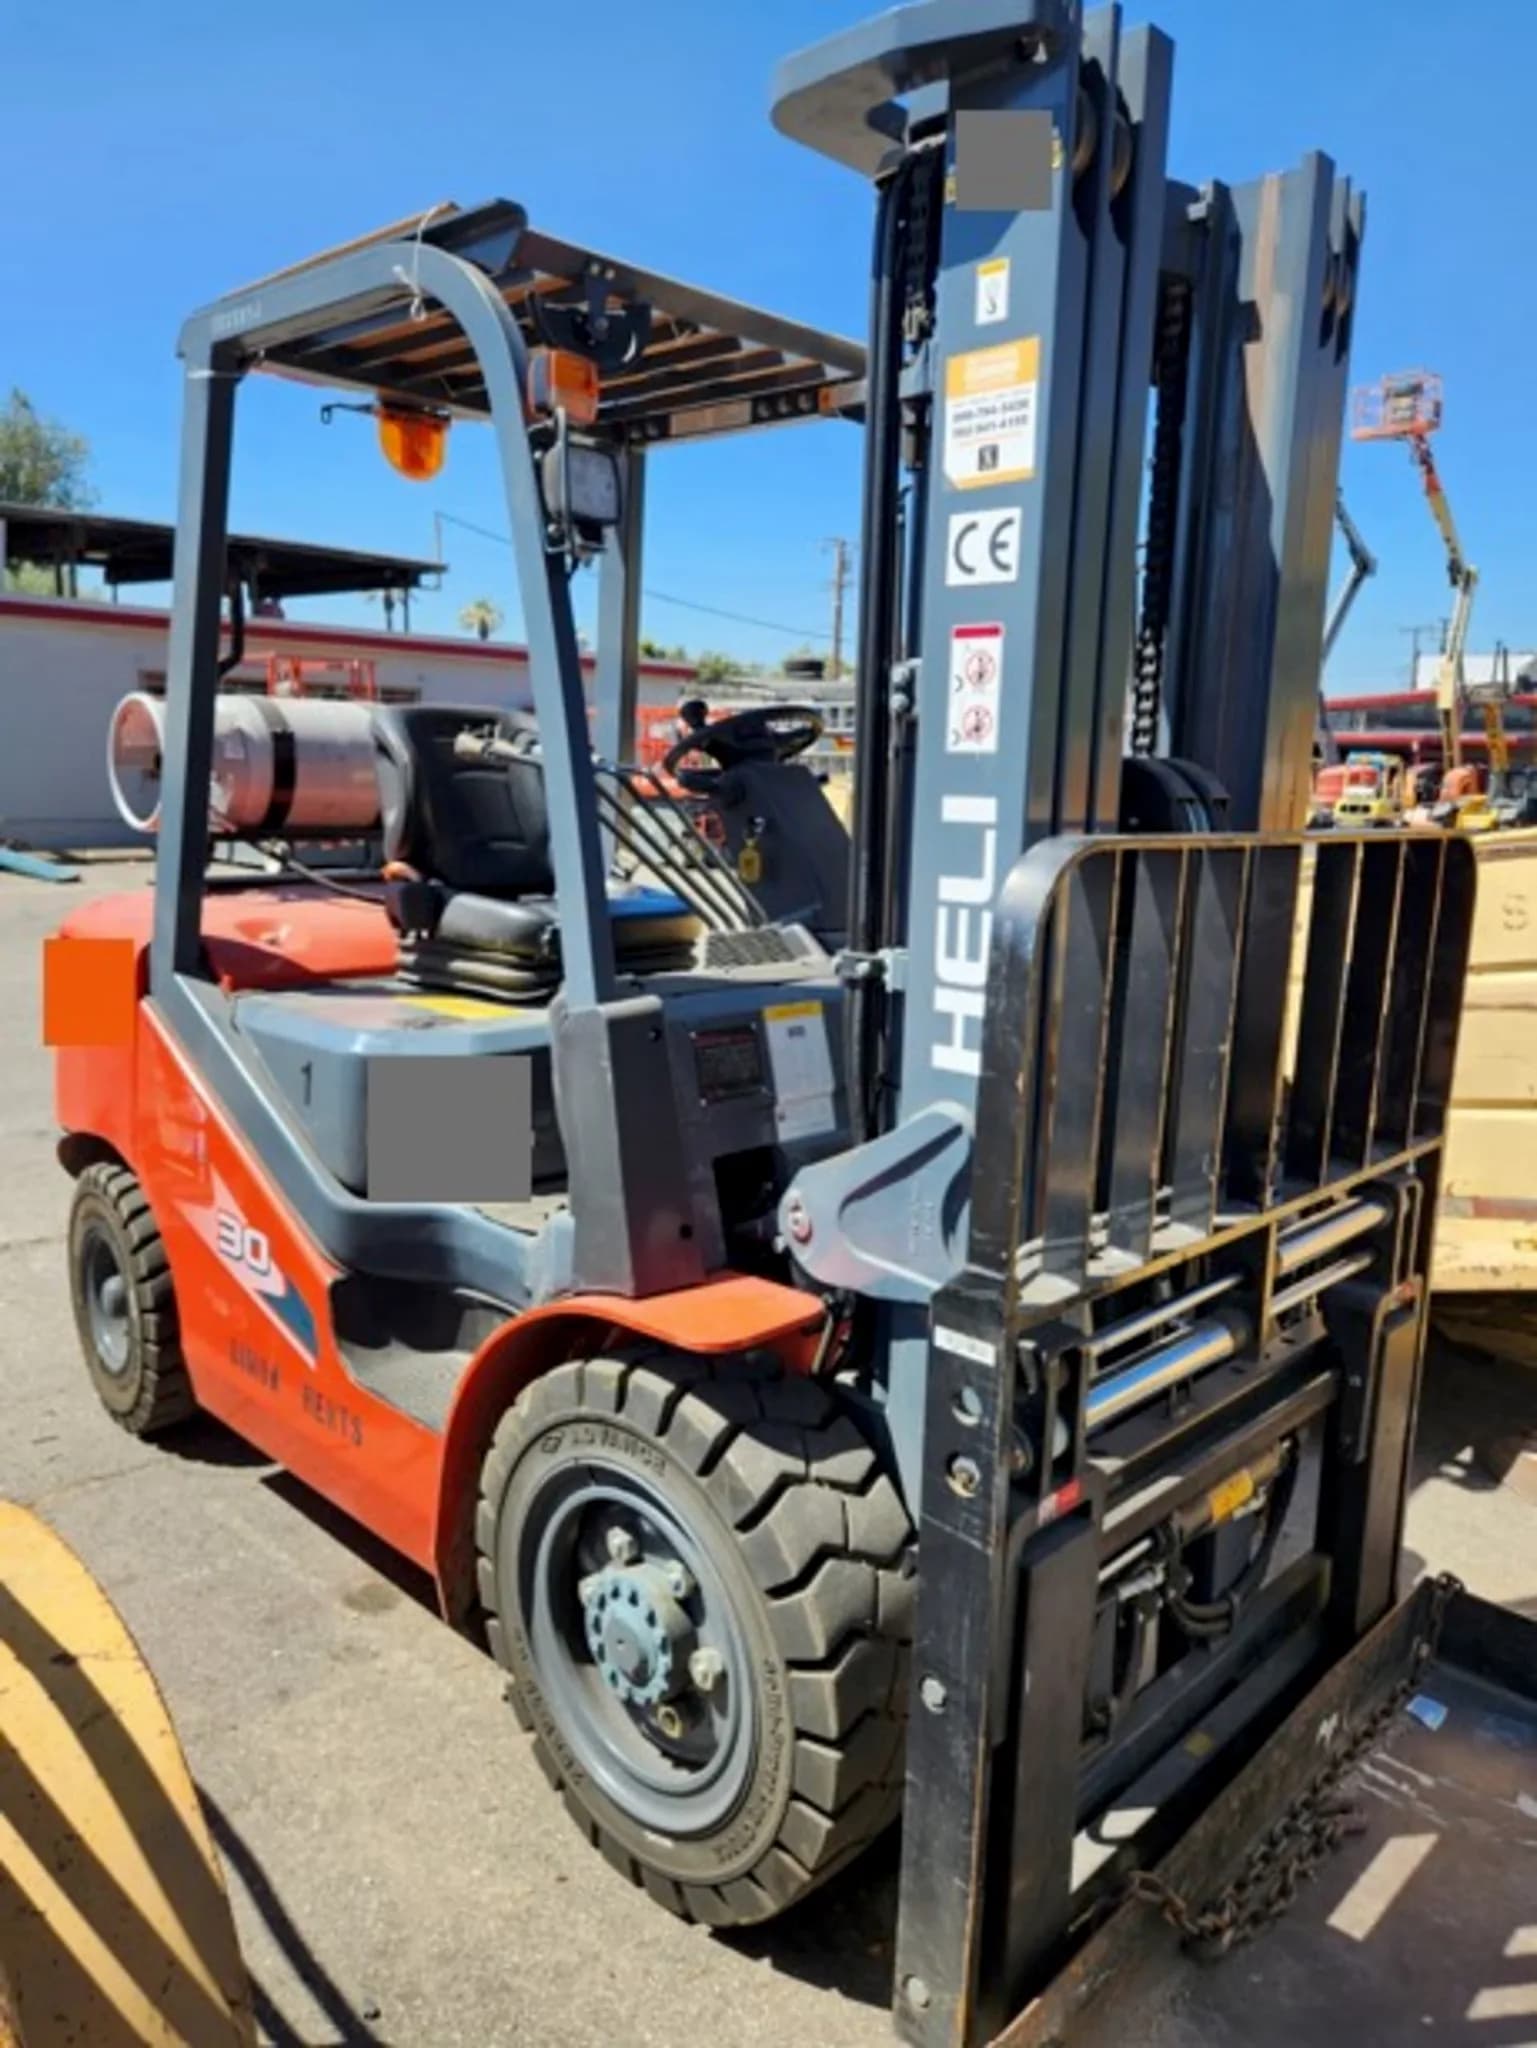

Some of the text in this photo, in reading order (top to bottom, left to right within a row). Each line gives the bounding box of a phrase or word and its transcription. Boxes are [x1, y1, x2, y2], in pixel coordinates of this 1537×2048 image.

[954, 517, 1014, 575] CE
[931, 795, 997, 1077] HELI
[217, 1209, 271, 1277] 30
